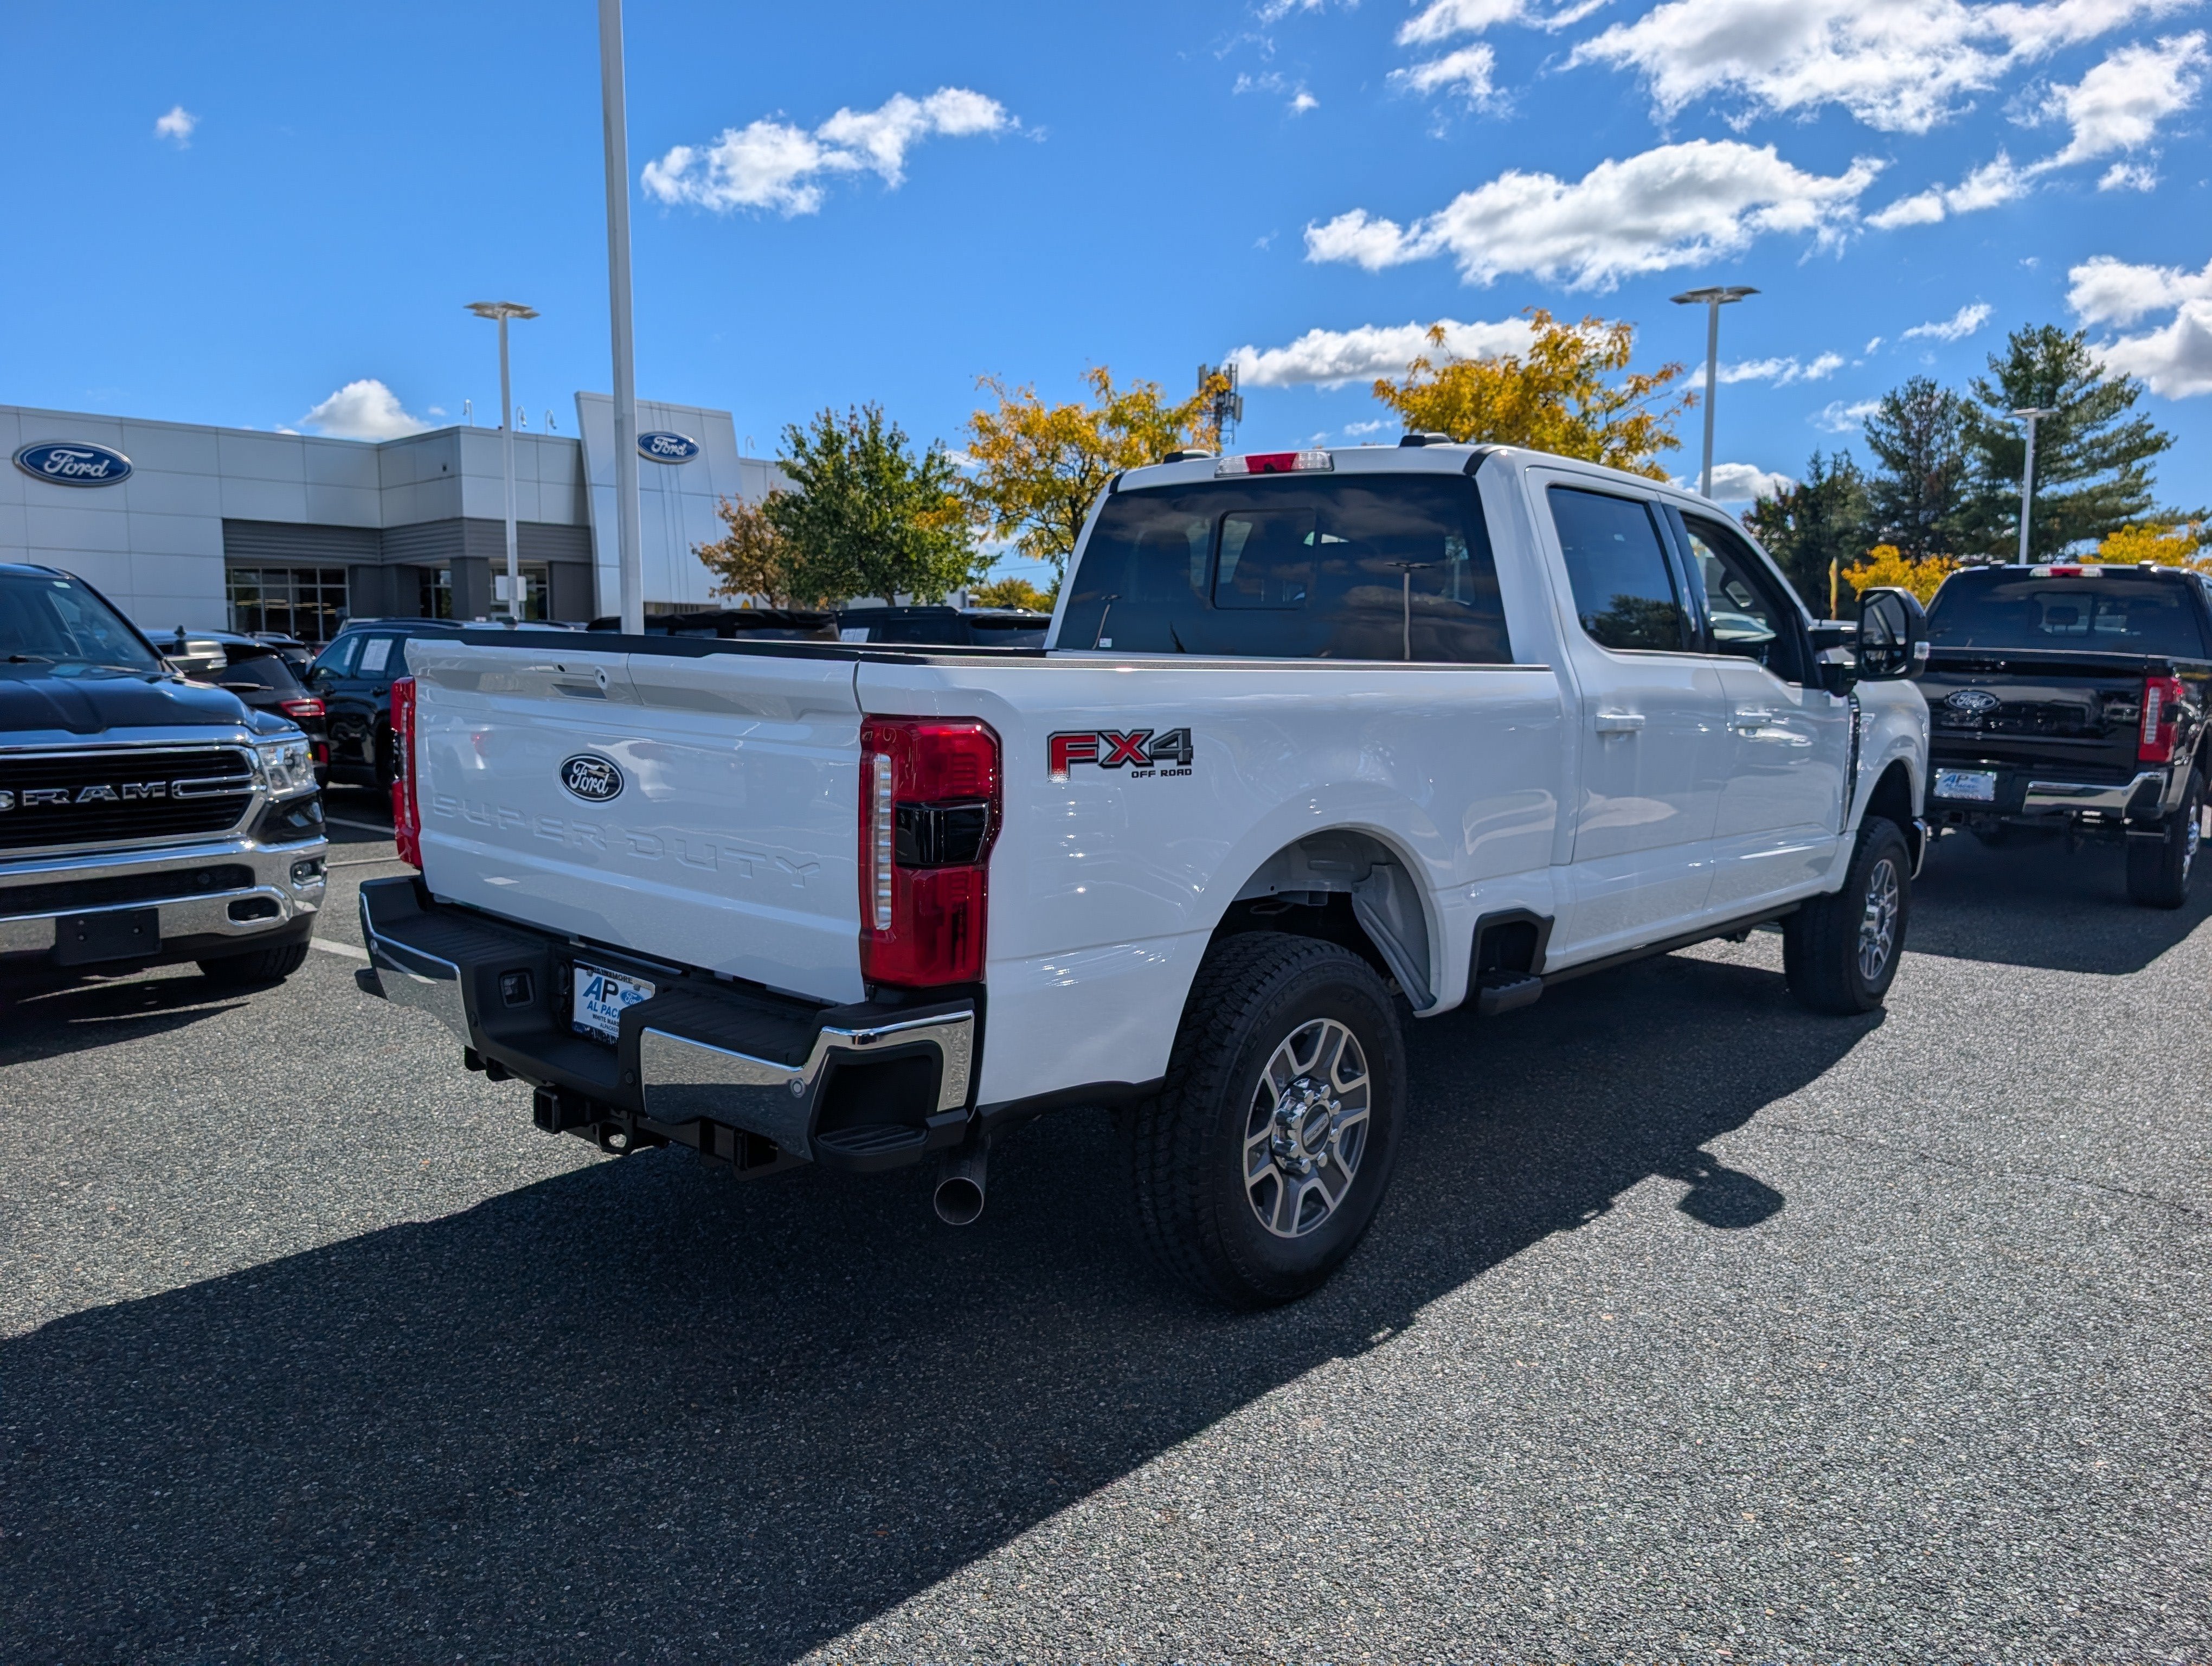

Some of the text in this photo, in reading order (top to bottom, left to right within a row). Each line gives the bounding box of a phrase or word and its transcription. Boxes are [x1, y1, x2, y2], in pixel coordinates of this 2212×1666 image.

[651, 436, 688, 456] Ford
[43, 449, 110, 478] Ford
[1956, 693, 1988, 707] Ford
[1047, 727, 1194, 784] FX4
[569, 760, 610, 794] Ford
[1131, 768, 1192, 779] OFF ROAD
[22, 781, 167, 806] RAM
[432, 792, 821, 888] SUPER DUTY
[582, 976, 619, 1003] AP
[587, 1000, 598, 1012] AL
[592, 1013, 607, 1023] WHITE
[1307, 1119, 1327, 1141] FORD
